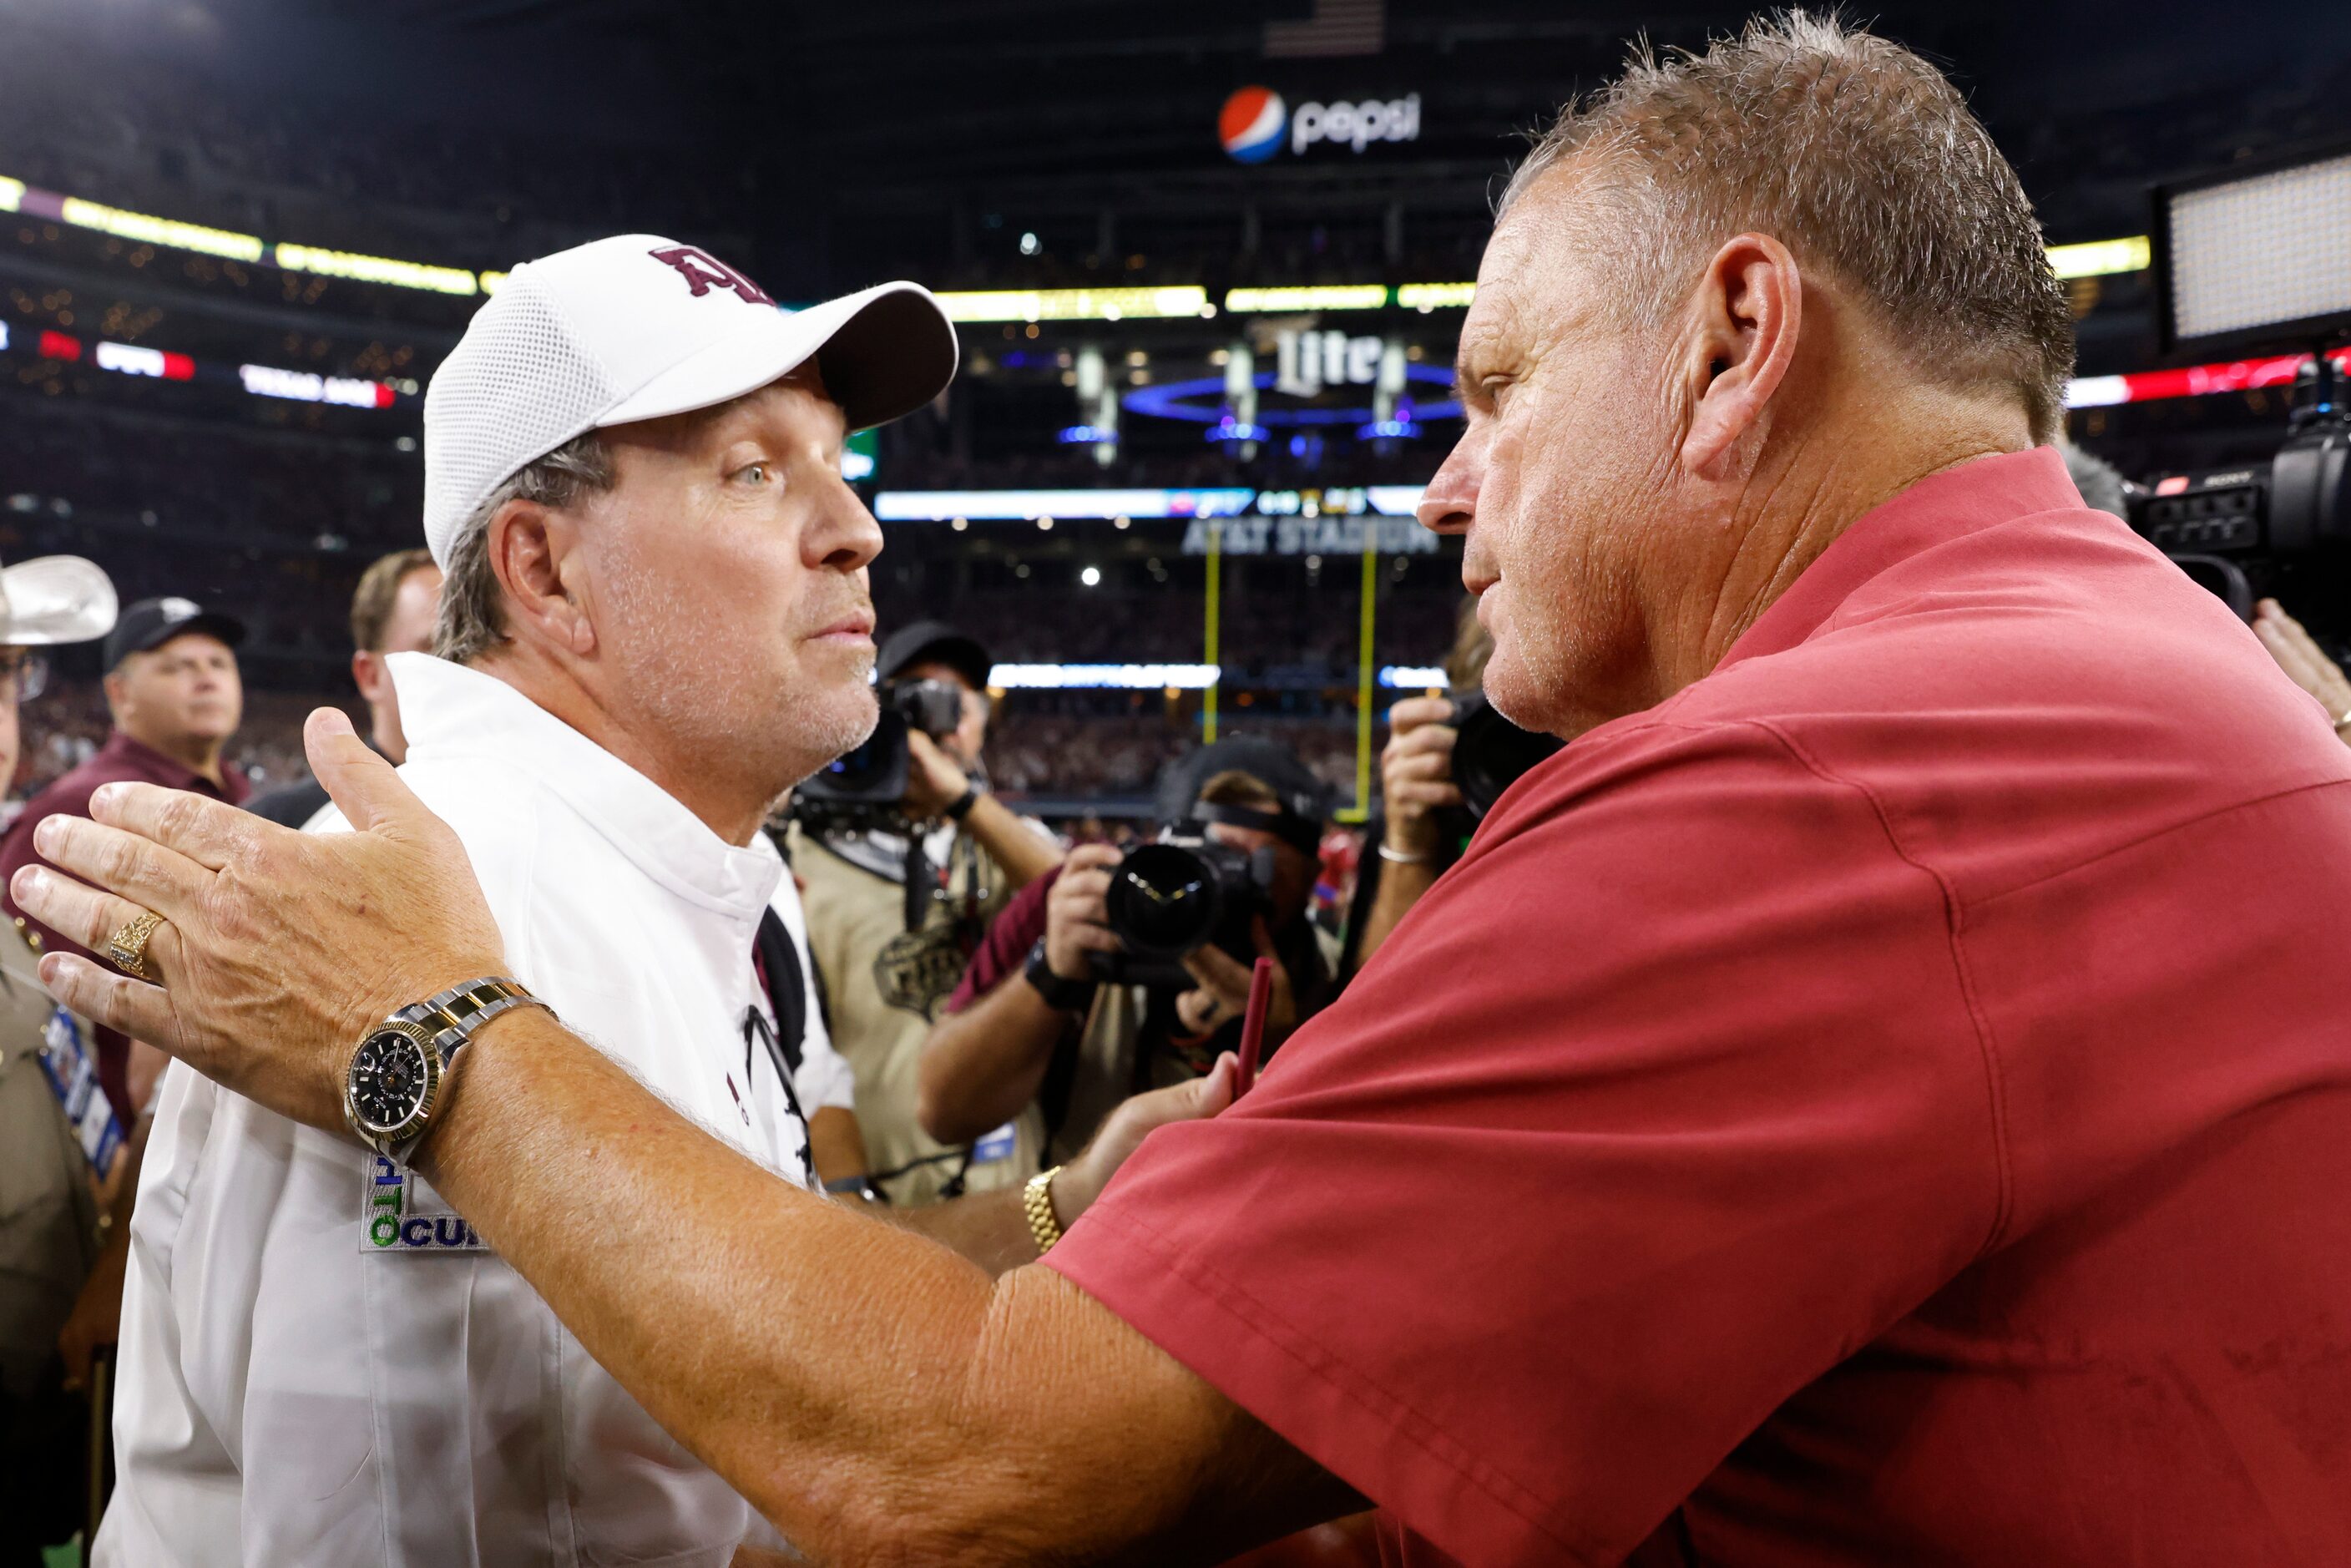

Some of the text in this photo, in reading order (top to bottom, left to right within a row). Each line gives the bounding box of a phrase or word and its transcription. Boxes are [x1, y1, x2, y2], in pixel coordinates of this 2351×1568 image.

[1292, 92, 1421, 155] pepsi
[1277, 329, 1383, 397] Lite
[373, 1096, 387, 1110] ROLEX
